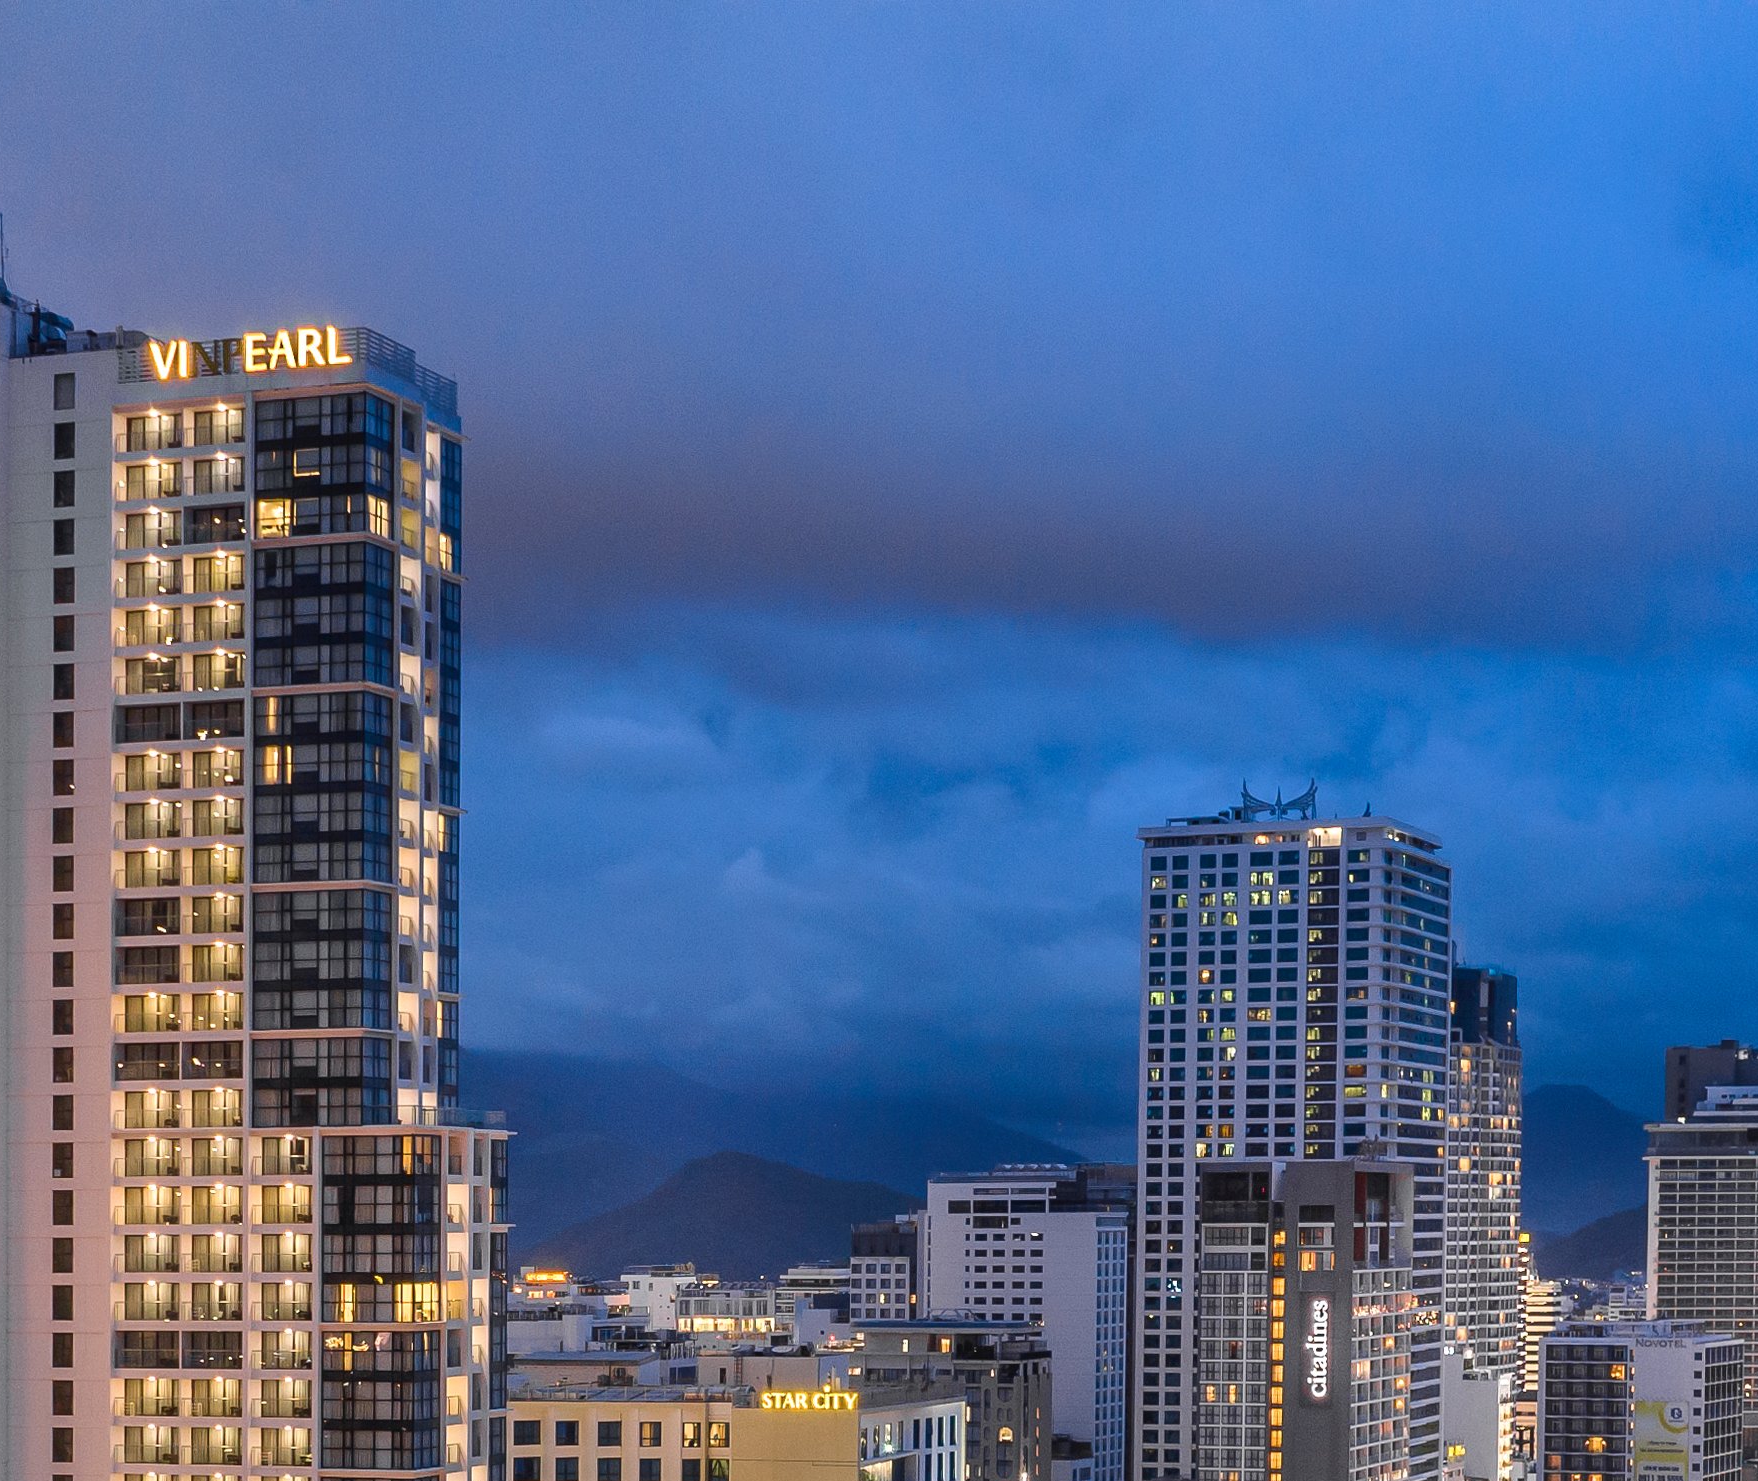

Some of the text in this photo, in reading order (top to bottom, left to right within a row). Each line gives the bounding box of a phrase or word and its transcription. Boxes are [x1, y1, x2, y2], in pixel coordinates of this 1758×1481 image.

[148, 325, 353, 381] VINPEARL
[1306, 1299, 1329, 1398] citadines
[1635, 1338, 1687, 1348] NOVOTEL
[761, 1392, 809, 1410] STAR
